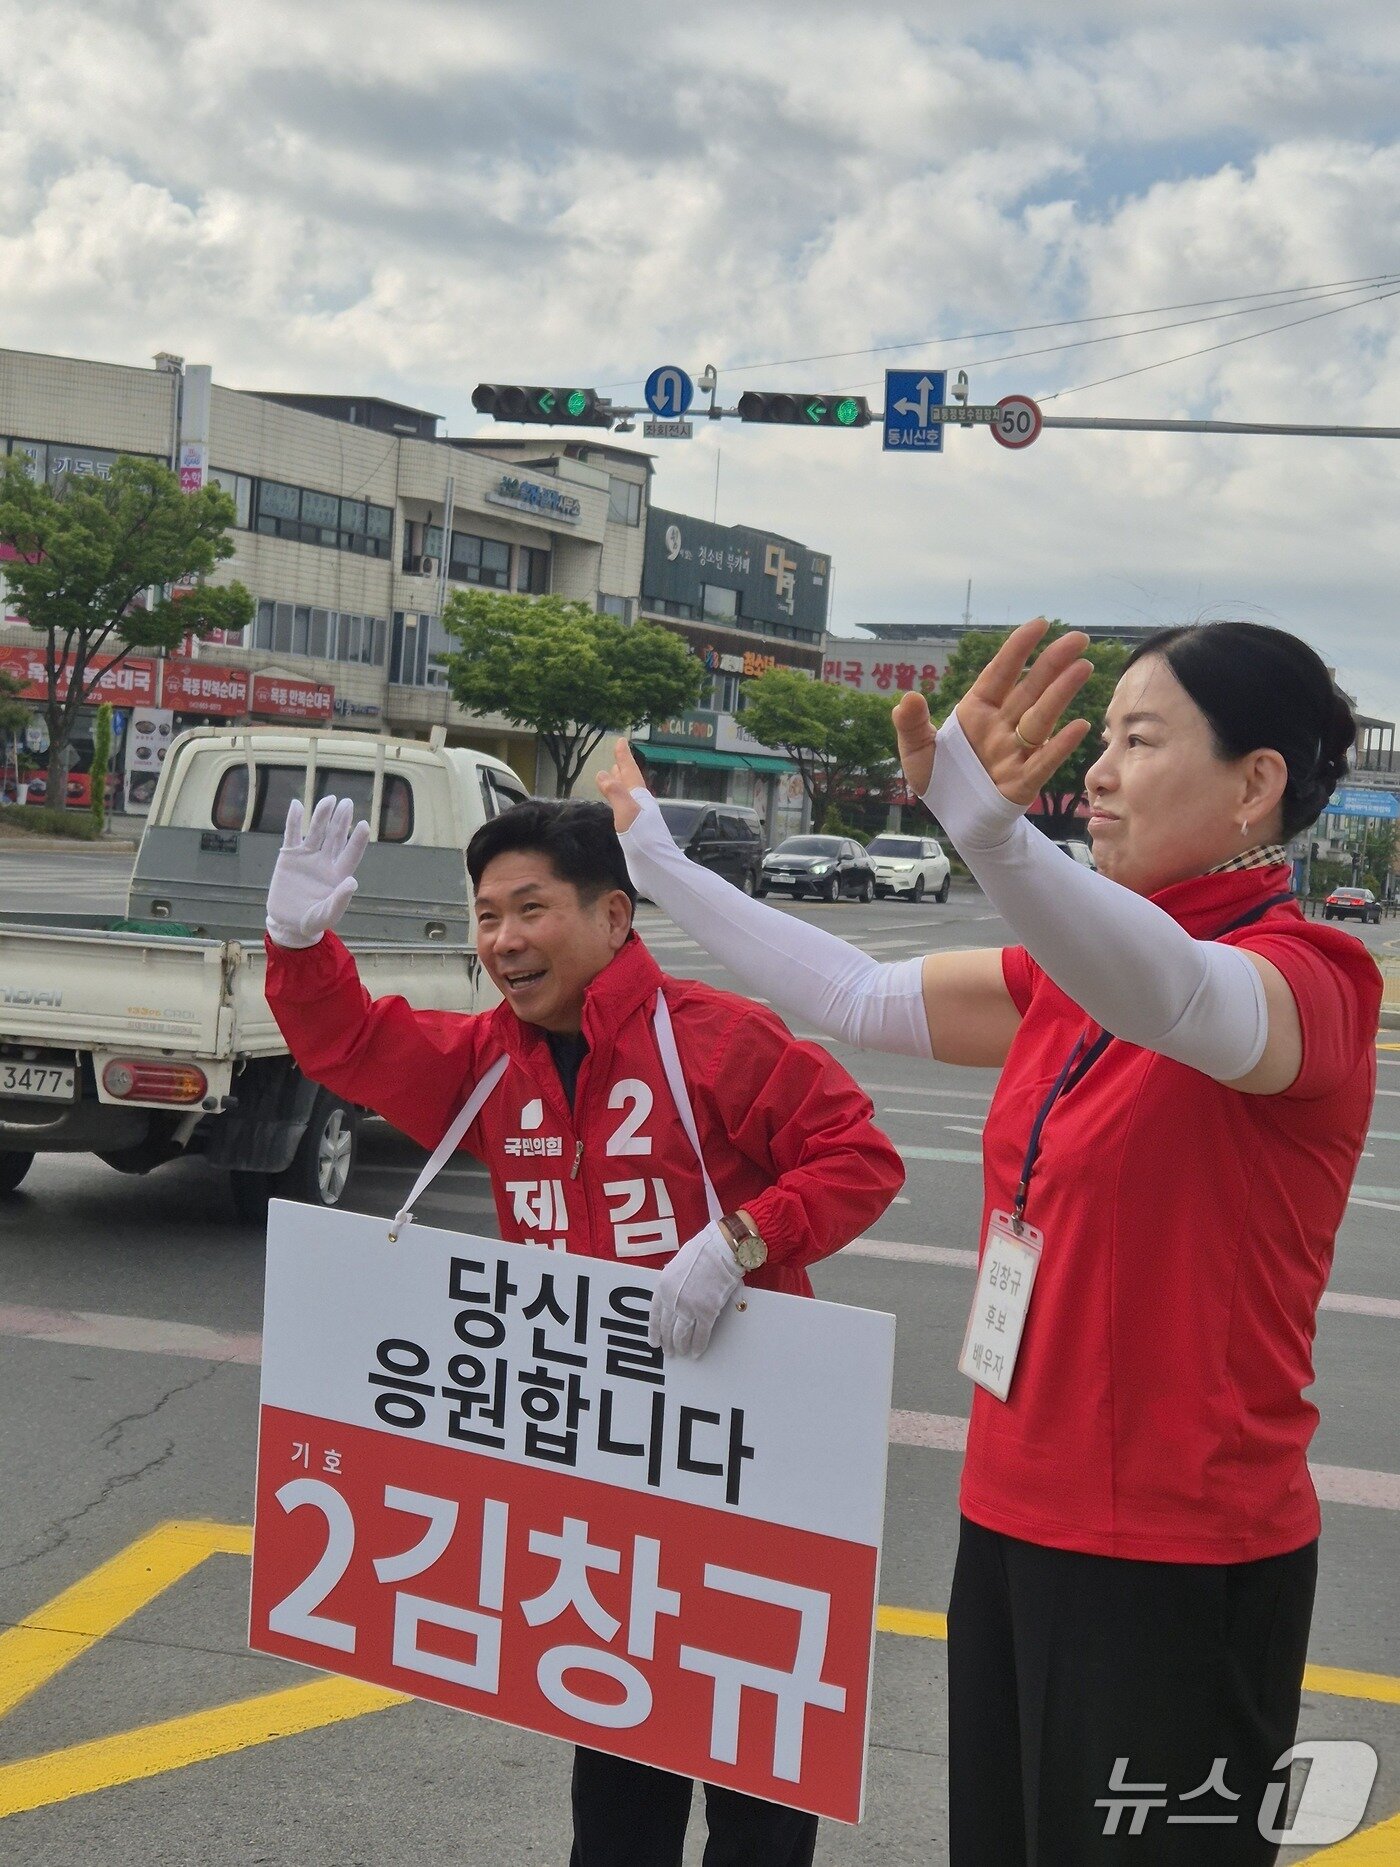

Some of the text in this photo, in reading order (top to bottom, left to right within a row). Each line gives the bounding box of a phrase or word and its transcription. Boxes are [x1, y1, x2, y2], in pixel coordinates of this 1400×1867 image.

[932, 407, 1000, 421] 교통정보수집장치
[1002, 410, 1031, 434] 50
[646, 424, 691, 437] 좌회전시
[888, 428, 940, 446] 동시신호
[699, 546, 723, 571] 청소년
[688, 721, 714, 738] FOOD
[4, 1066, 63, 1093] 3477
[606, 1078, 654, 1157] 2
[504, 1136, 563, 1157] 국민의힘
[603, 1177, 680, 1258] 김
[990, 1260, 1022, 1296] 김창규
[448, 1256, 666, 1386] 당신을
[985, 1304, 1007, 1334] 후보
[972, 1342, 1005, 1382] 배우자
[368, 1337, 755, 1506] 응원합니다
